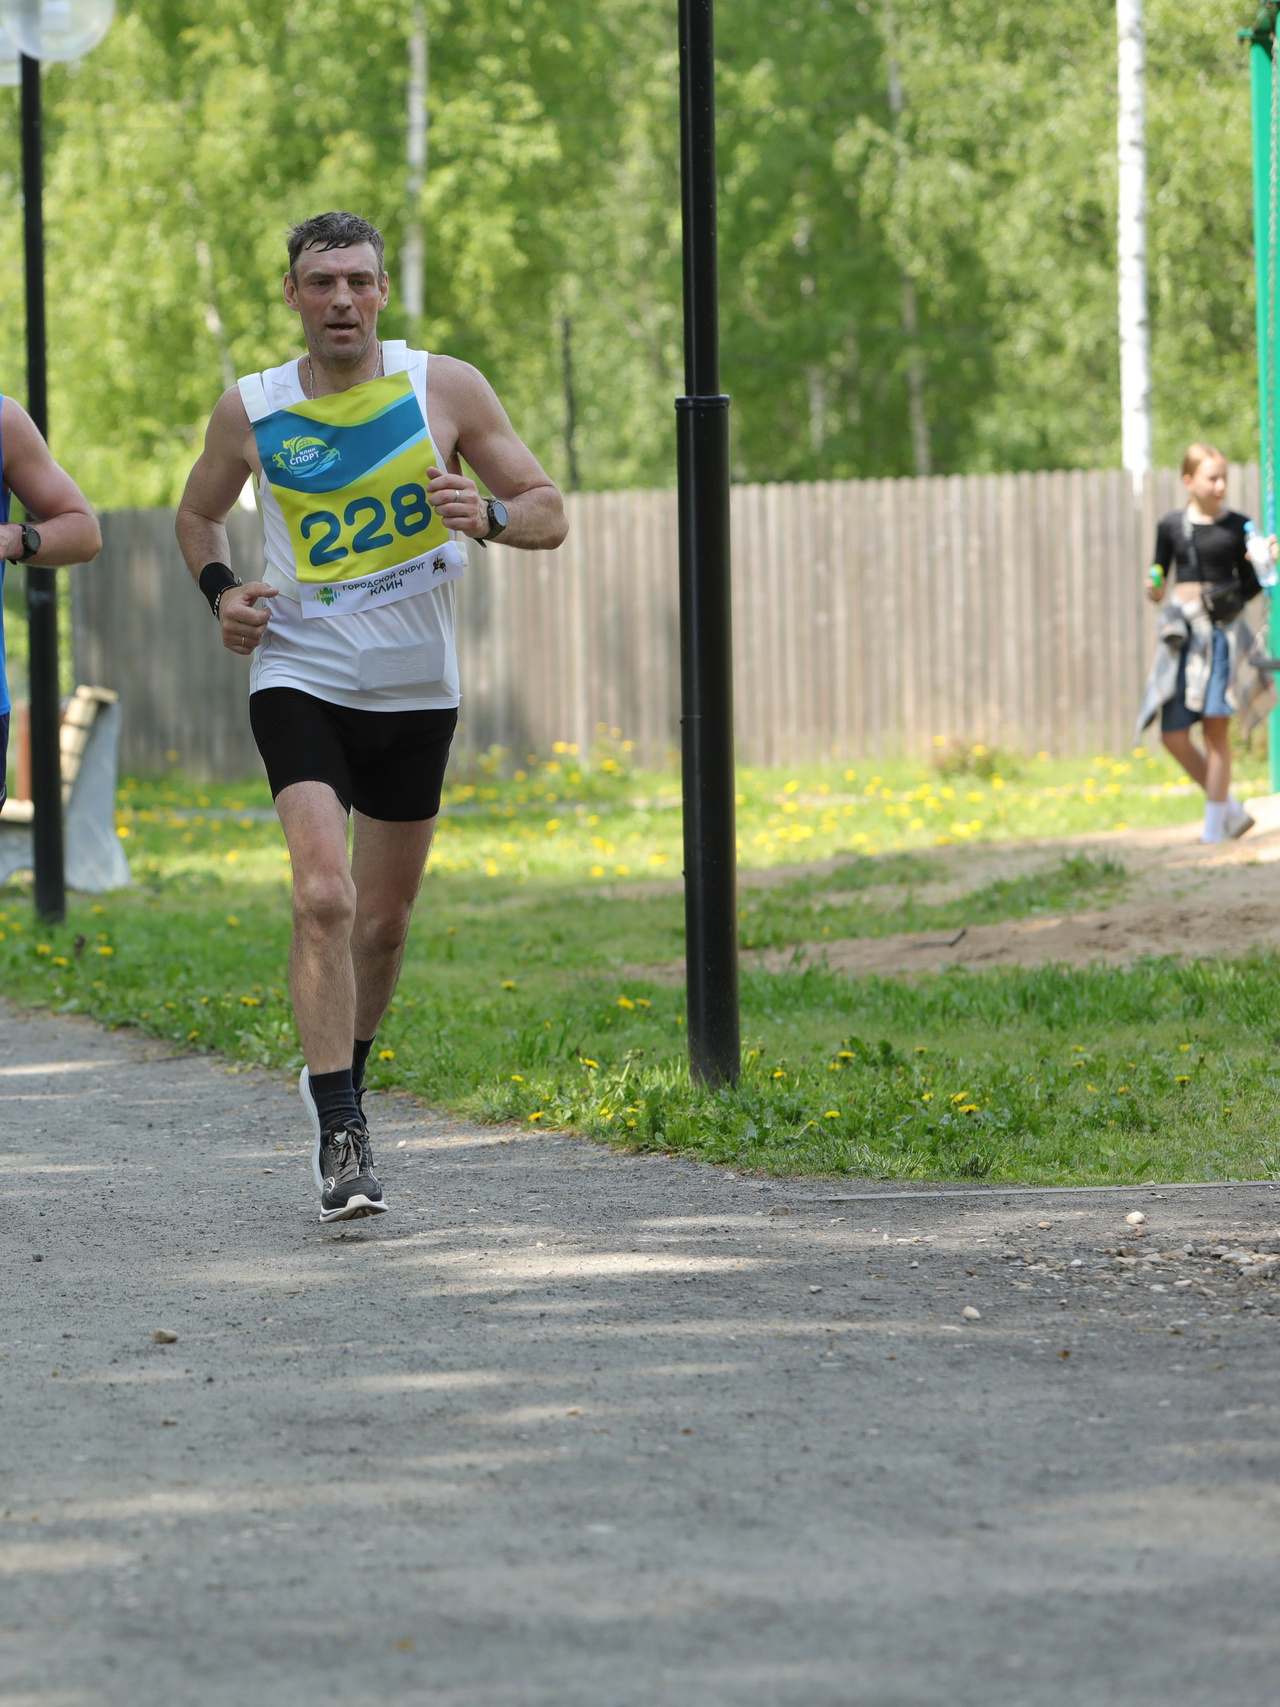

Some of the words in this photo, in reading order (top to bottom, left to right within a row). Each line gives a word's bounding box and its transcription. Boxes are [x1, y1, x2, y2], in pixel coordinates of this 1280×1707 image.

[289, 450, 320, 466] СПОРТ
[300, 482, 432, 567] 228
[342, 571, 396, 592] ГОРОДСКОЙ
[398, 561, 426, 577] ОКРУГ
[370, 578, 404, 597] КЛИН
